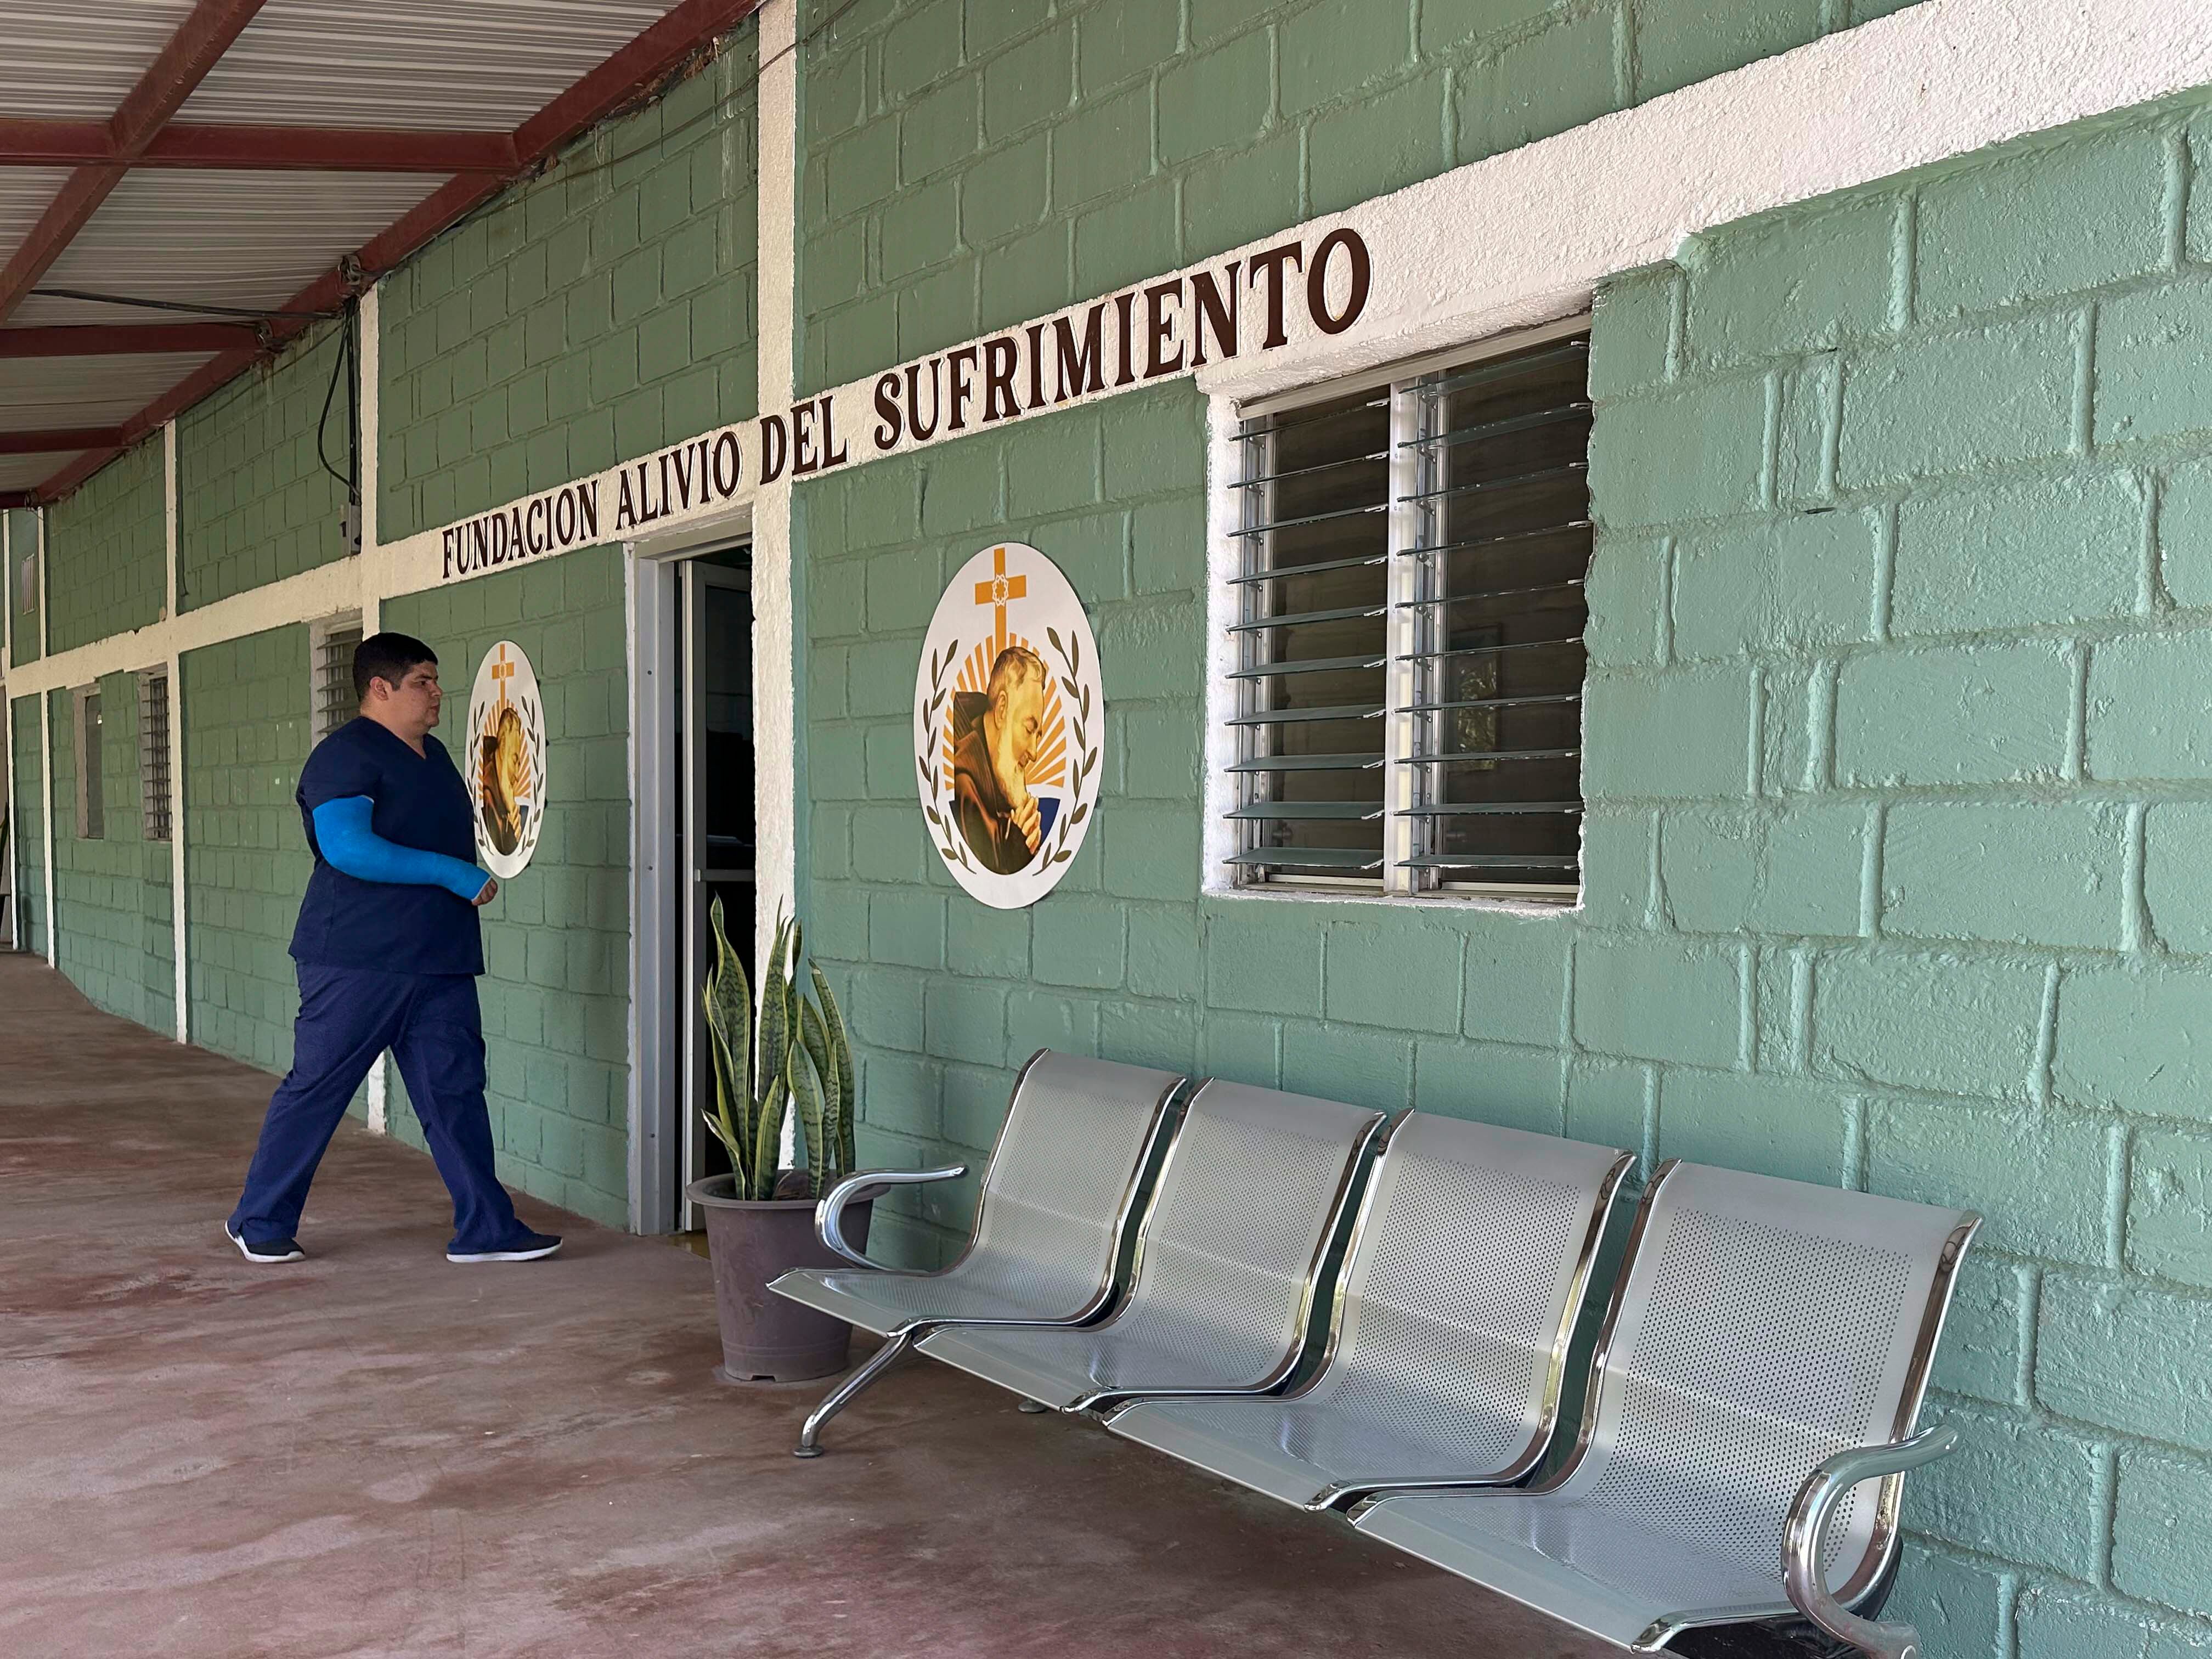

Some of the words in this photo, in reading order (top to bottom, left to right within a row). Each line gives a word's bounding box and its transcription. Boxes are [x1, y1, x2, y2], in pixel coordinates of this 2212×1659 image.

[442, 478, 600, 579] FUNDACION
[615, 431, 741, 531] ALIVIO
[759, 394, 848, 487] DEL
[873, 227, 1371, 451] SUFRIMIENTO
